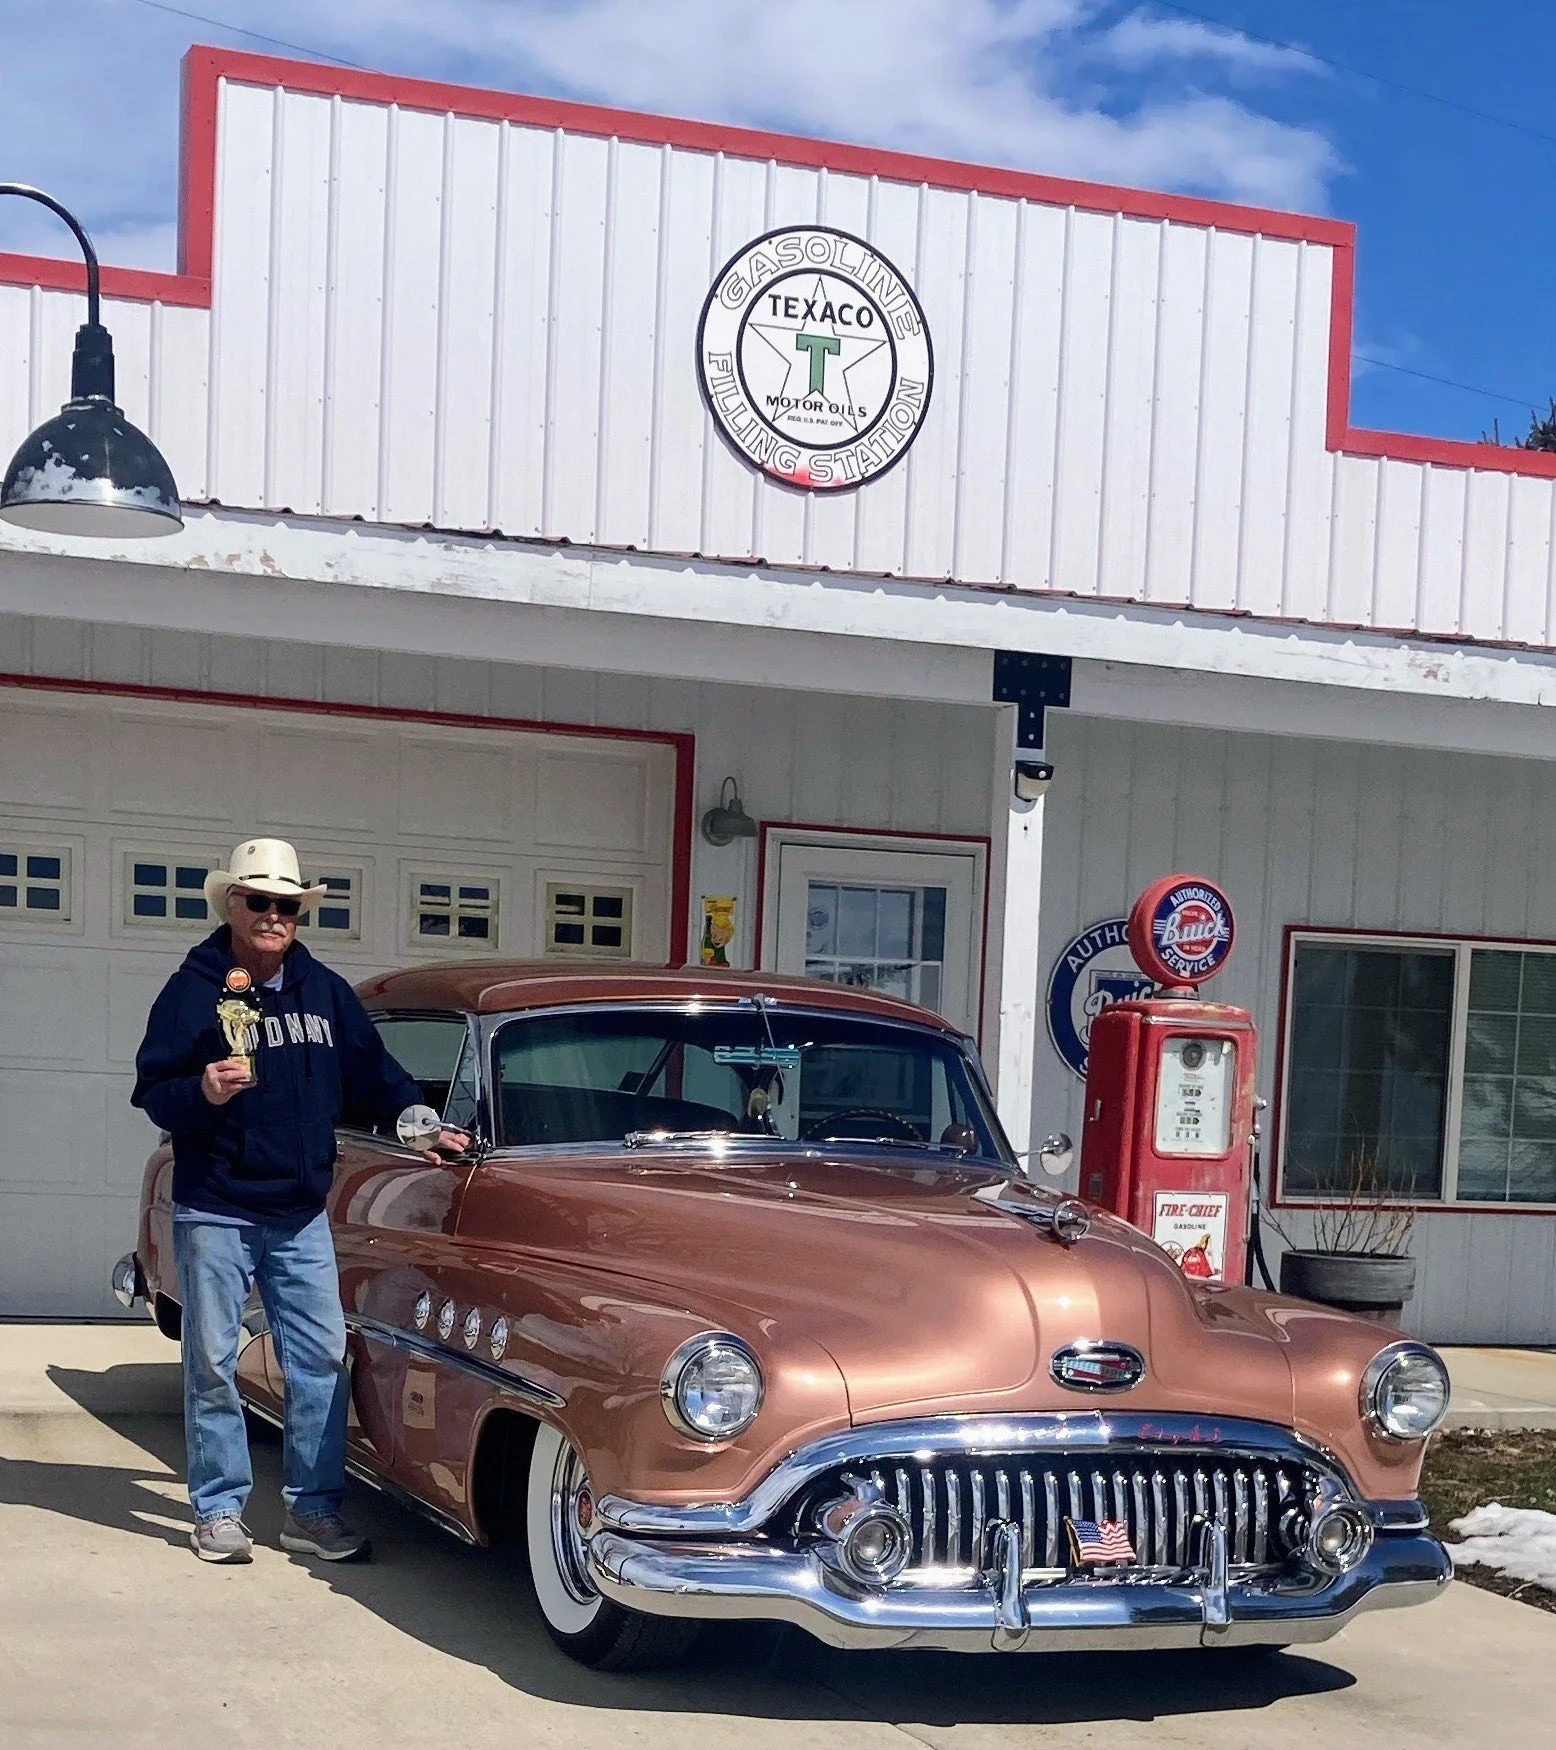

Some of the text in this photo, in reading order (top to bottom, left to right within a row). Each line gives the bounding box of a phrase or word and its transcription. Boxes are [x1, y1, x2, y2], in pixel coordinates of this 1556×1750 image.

[720, 236, 921, 341] GASOLINE
[767, 293, 874, 329] TEXACO
[795, 333, 841, 395] T
[708, 351, 925, 483] FILLING STATION
[766, 395, 867, 418] MOTOR OILS
[1170, 887, 1222, 911] AUTHORIZED
[1159, 910, 1228, 947] Buick
[1161, 948, 1216, 973] SERVICE
